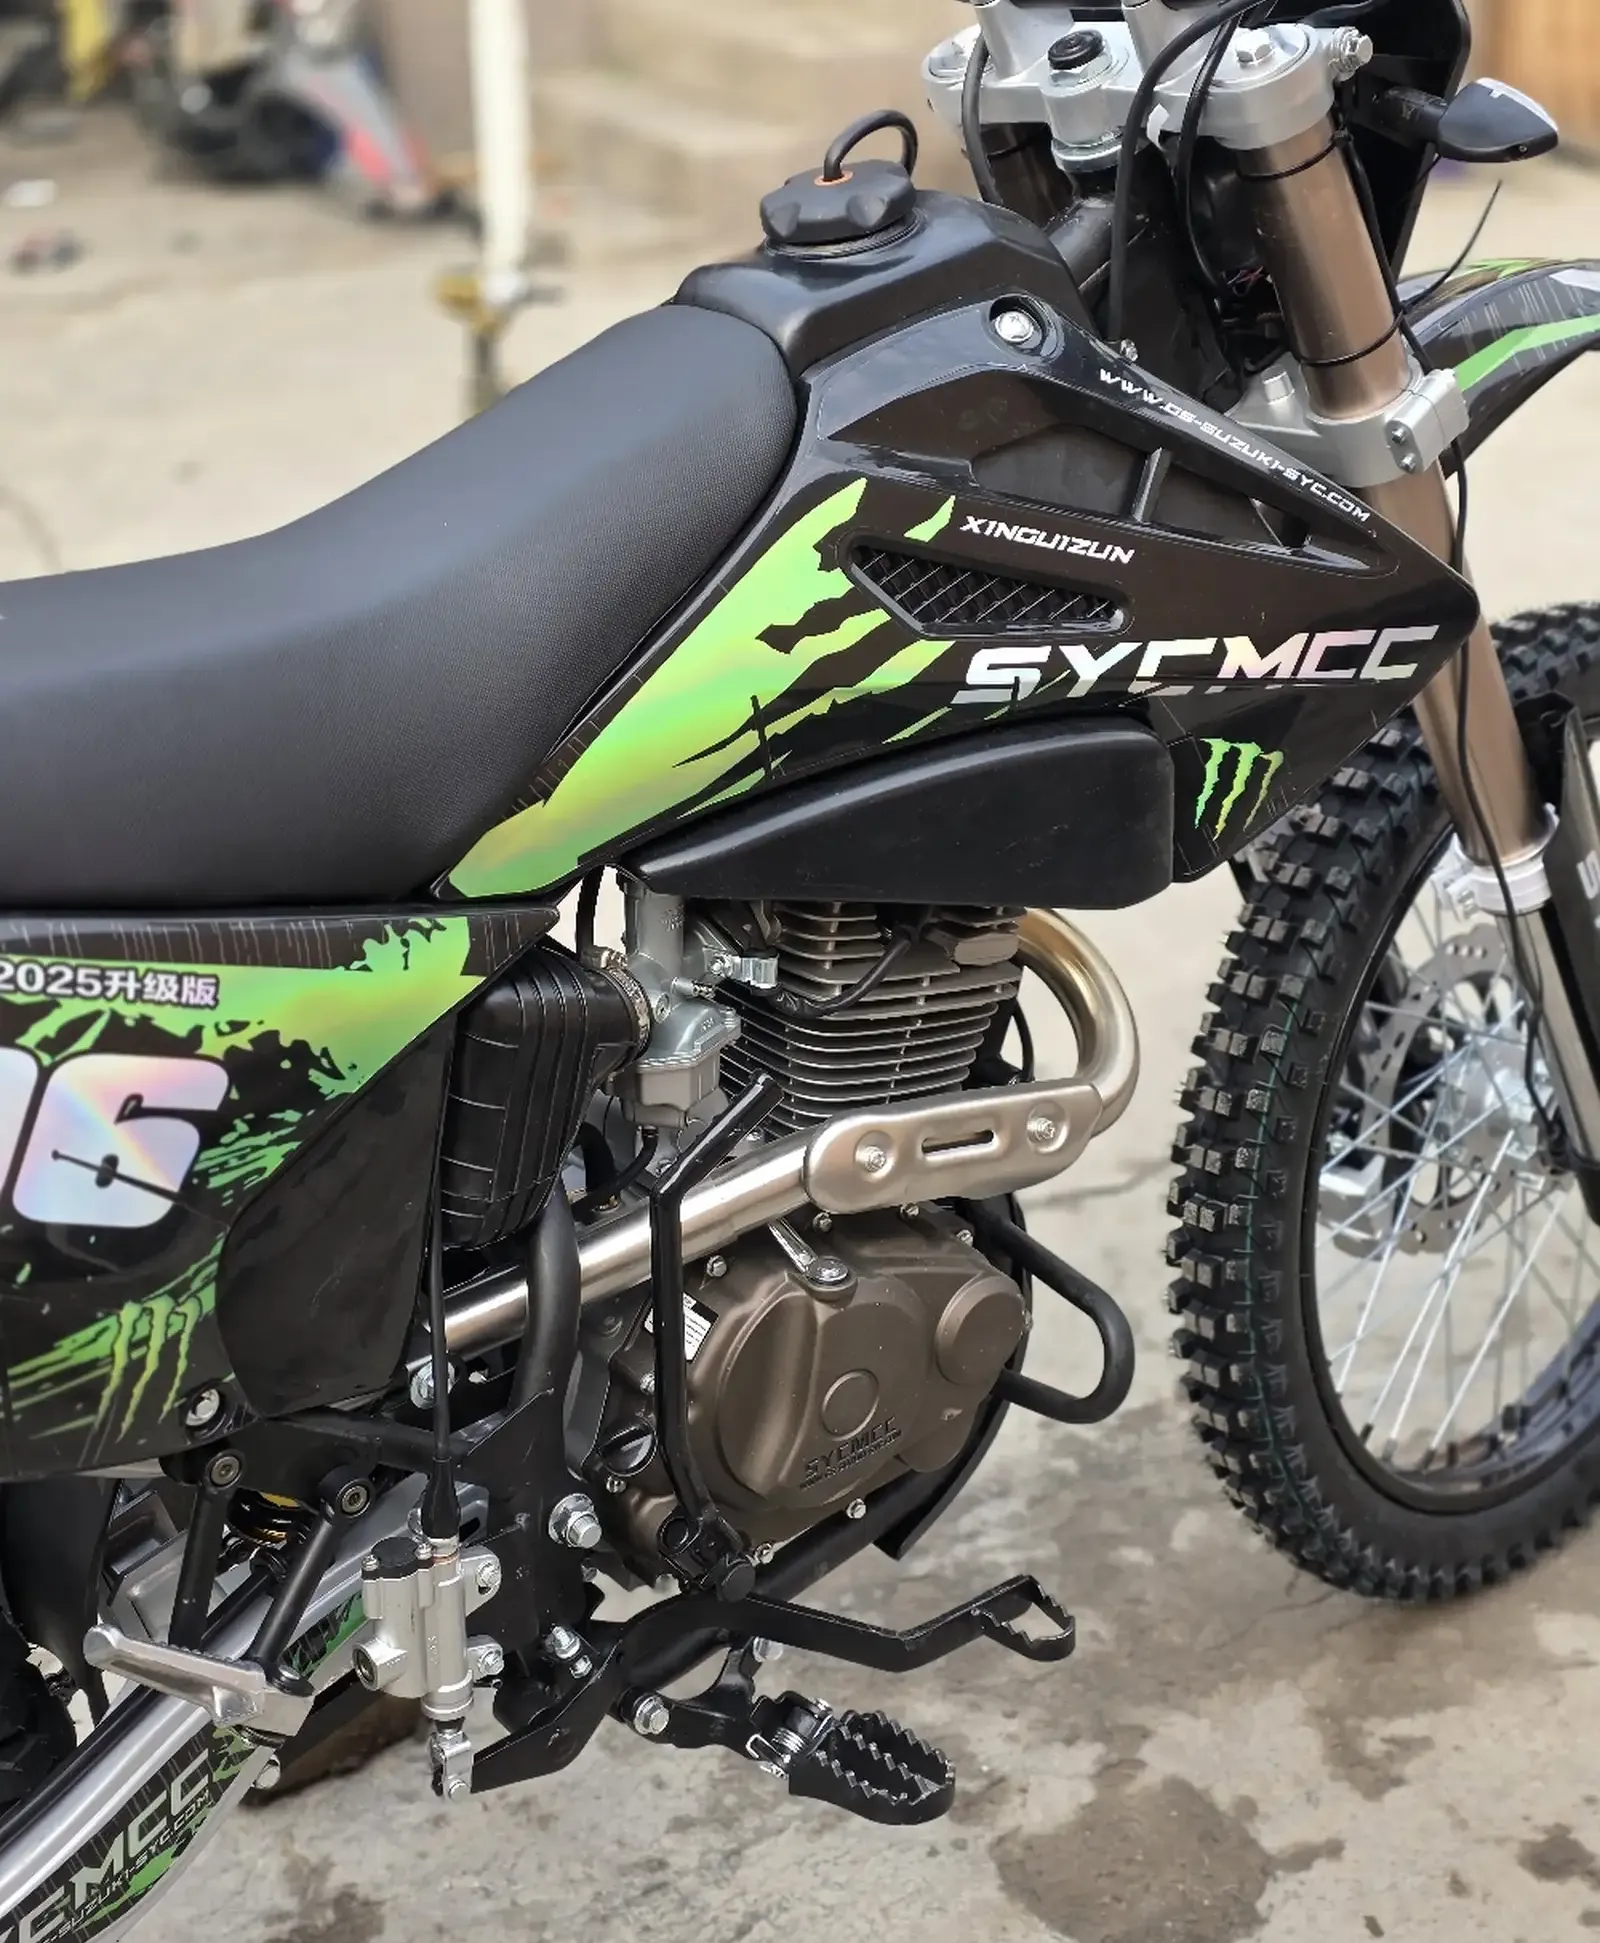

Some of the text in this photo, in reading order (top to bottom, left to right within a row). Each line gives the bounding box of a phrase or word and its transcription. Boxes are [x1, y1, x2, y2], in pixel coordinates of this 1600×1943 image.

[950, 624, 1440, 704] SYCMCC
[0, 961, 218, 1006] 2025升级版
[804, 1416, 896, 1482] SYCMCC
